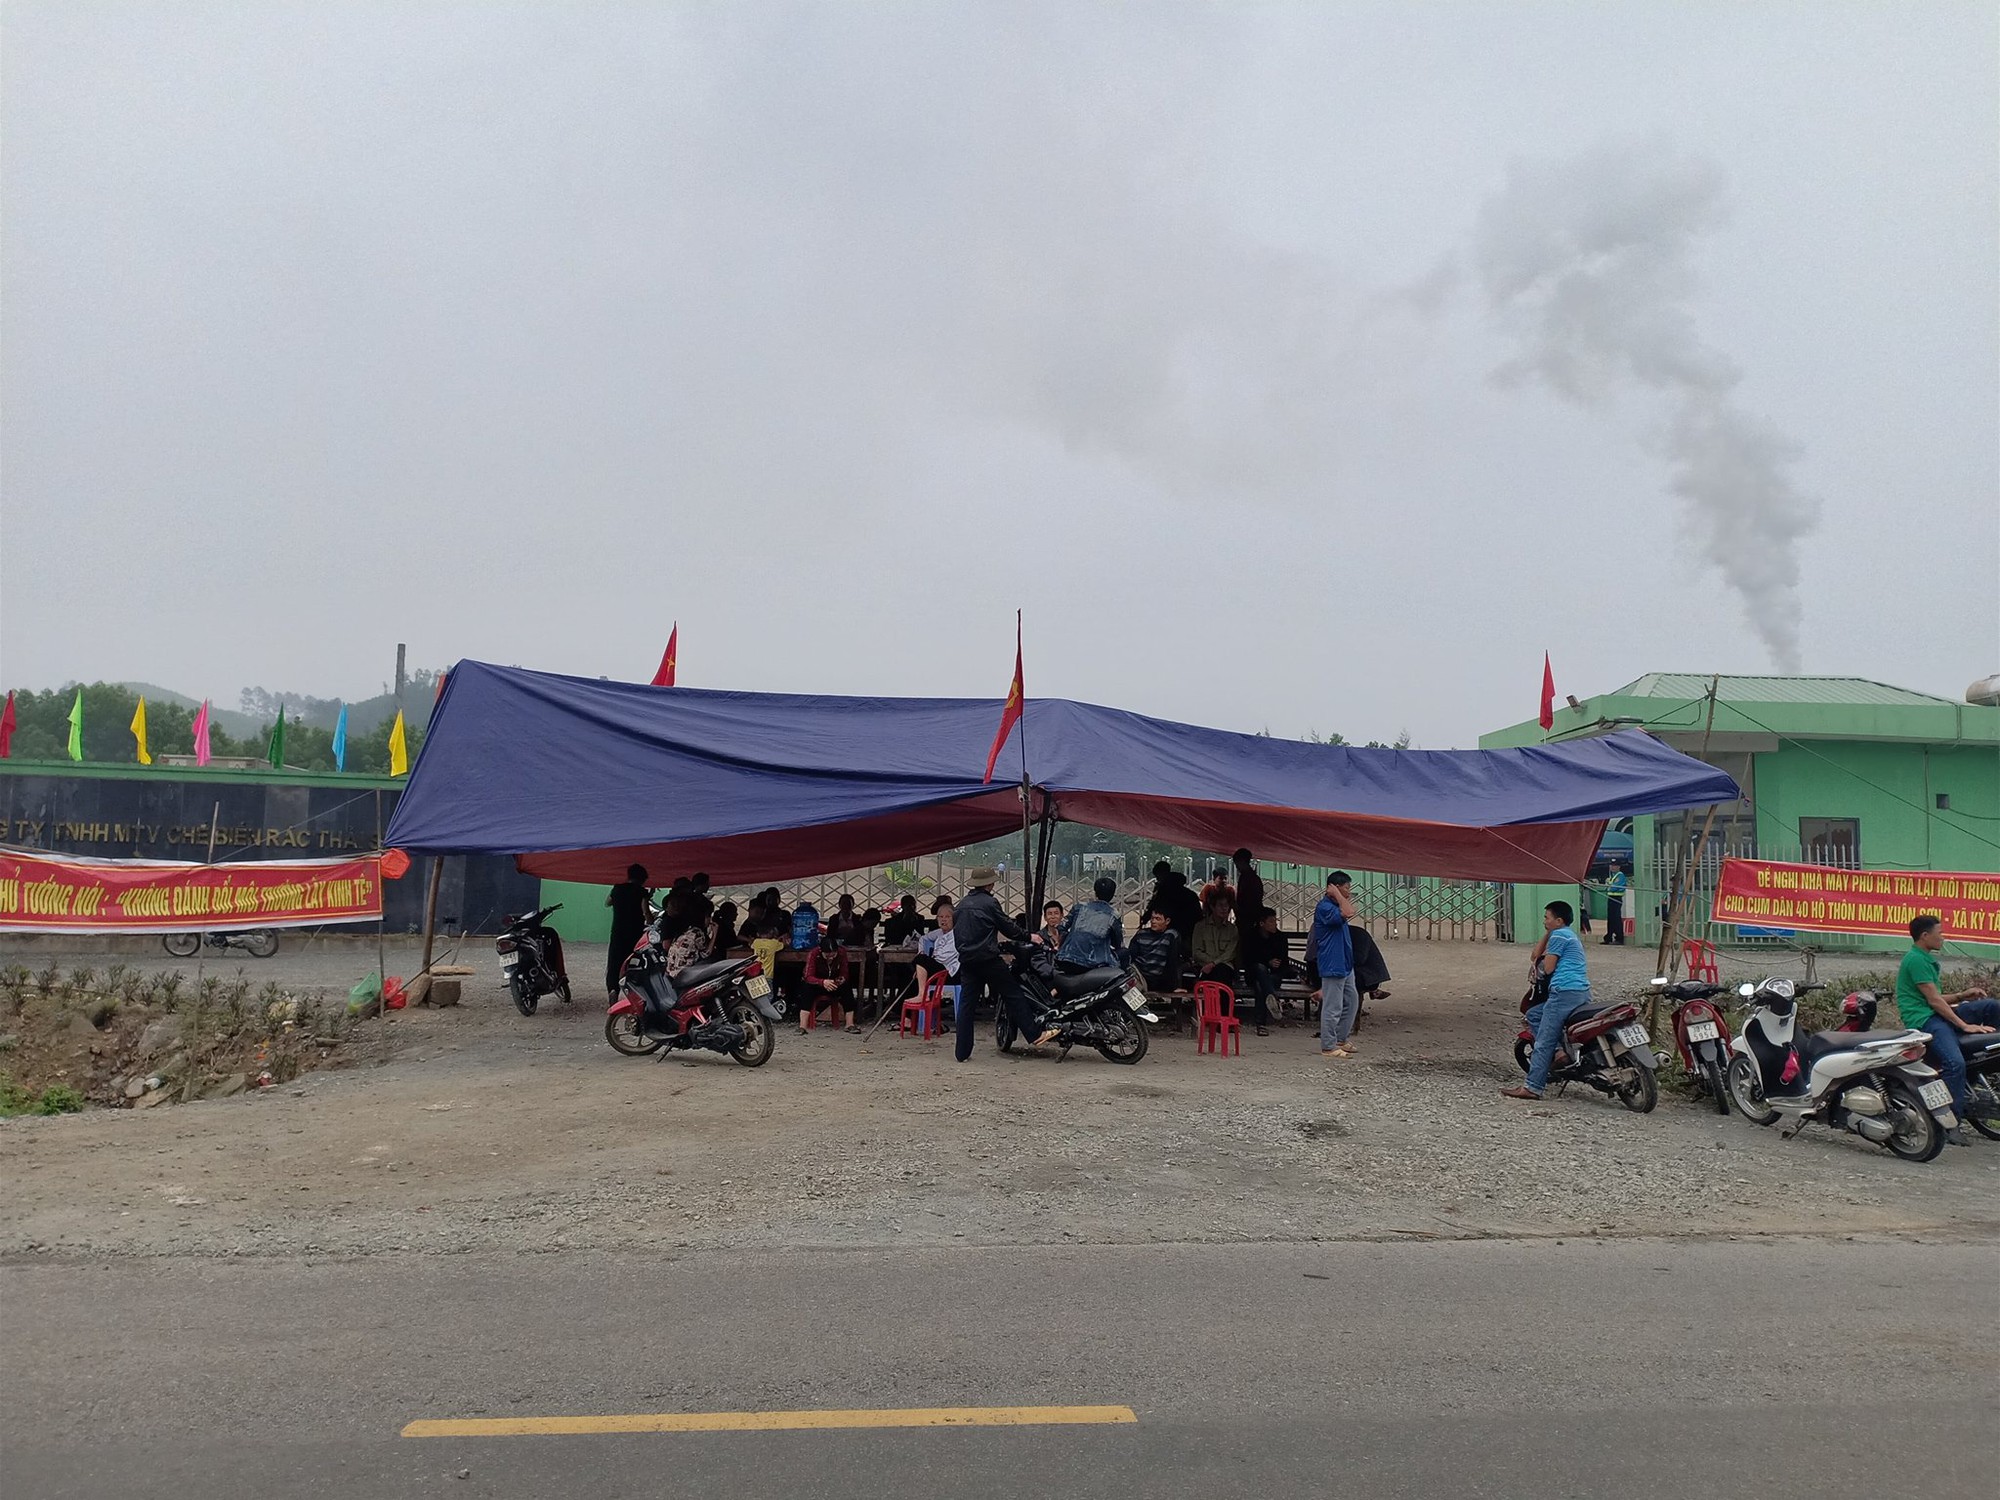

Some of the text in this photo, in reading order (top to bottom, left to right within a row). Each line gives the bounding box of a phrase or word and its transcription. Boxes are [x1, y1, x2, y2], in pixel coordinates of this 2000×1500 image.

[52, 822, 109, 842] TNHH
[114, 823, 160, 843] MTV
[265, 825, 311, 848] RÁC
[23, 874, 74, 915] TƯỚNG
[173, 880, 210, 915] ĐÁNH
[235, 881, 259, 913] MÔI
[327, 880, 352, 908] KINH
[1757, 865, 1771, 888] ĐỀ
[1774, 871, 1798, 893] NGHỊ
[1801, 869, 1822, 890] NHÀ
[1826, 869, 1850, 892] MÁY
[1852, 871, 1874, 893] PHÚ
[1918, 878, 1934, 900] LẠI
[1938, 876, 1959, 899] MÔI
[1724, 895, 1745, 913] CHO
[1747, 897, 1770, 918] CỤM
[1772, 896, 1794, 917] DÂN
[1796, 901, 1809, 918] 40
[1811, 897, 1825, 923] HỘ
[1828, 898, 1856, 921] THÔN
[1858, 903, 1884, 923] NAM
[1886, 902, 1916, 925] XUÂN
[1952, 907, 1968, 929] XÃ
[1970, 908, 1986, 930] KỲ
